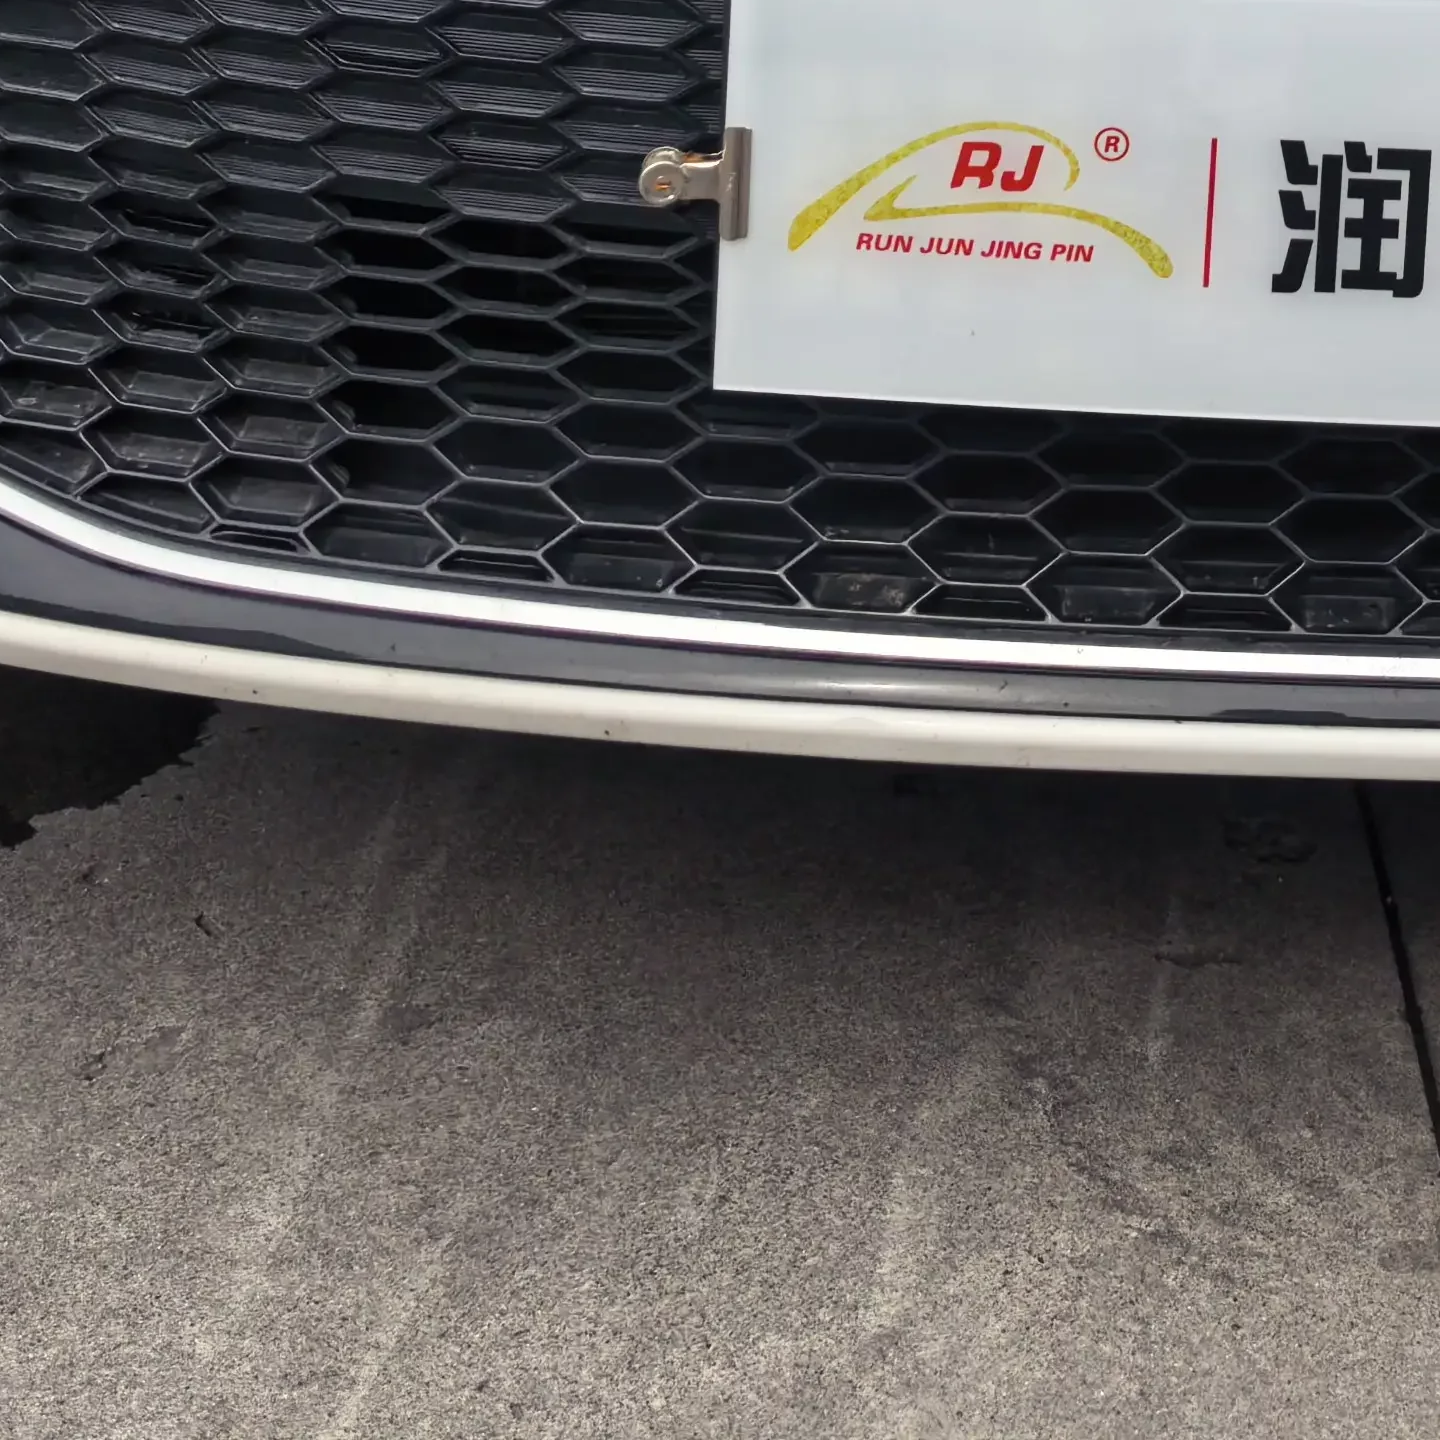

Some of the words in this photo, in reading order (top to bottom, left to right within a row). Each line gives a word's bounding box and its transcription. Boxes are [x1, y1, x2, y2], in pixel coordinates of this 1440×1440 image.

[950, 141, 1044, 192] RJ
[856, 232, 913, 254] RUN
[920, 236, 973, 257] JUN
[981, 239, 1042, 261] JING
[1050, 243, 1094, 263] PIN
